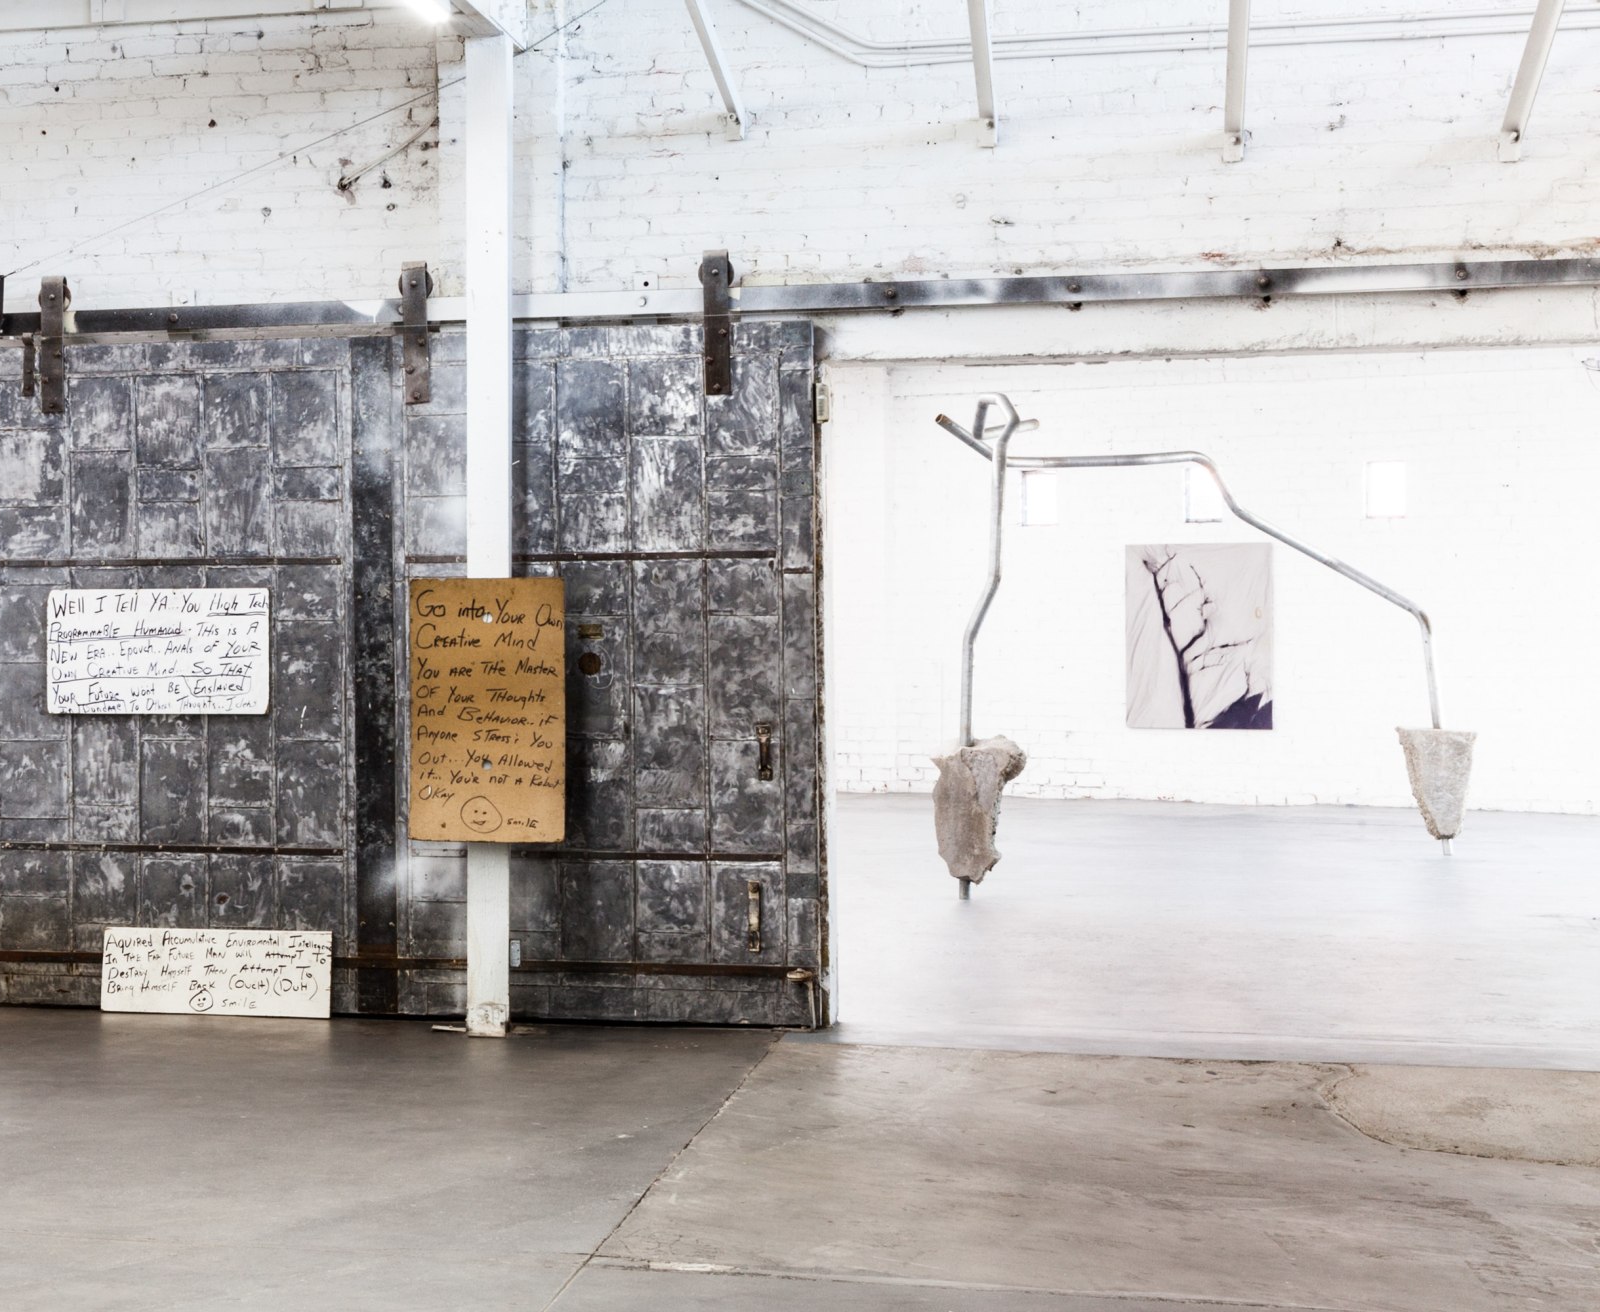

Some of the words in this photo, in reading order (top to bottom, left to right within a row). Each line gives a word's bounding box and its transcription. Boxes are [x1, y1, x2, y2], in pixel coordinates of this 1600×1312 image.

[416, 589, 445, 617] Go
[228, 624, 237, 636] is
[247, 622, 259, 635] A
[494, 629, 540, 651] Mind
